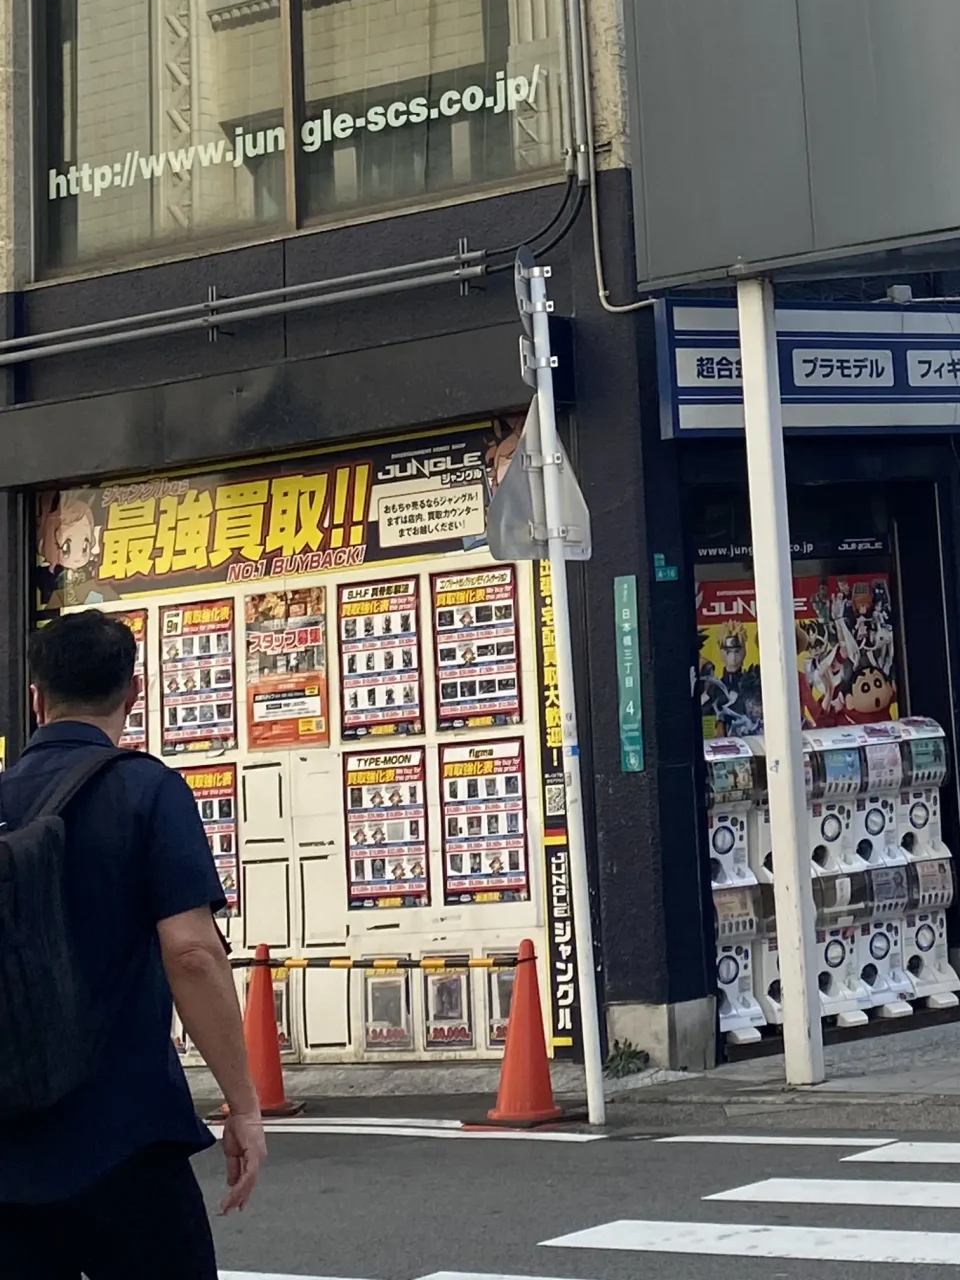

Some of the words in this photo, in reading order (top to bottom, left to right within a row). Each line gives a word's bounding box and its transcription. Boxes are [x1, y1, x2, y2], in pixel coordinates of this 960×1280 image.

[801, 356, 886, 380] プラモデル
[377, 451, 482, 478] JUNGLE
[441, 468, 483, 484] ジャングル
[98, 463, 372, 580] 最強買取!!
[226, 558, 267, 584] NO.1
[271, 544, 367, 578] BUYBACK!
[702, 596, 808, 618] JUNE
[249, 627, 323, 654] スタッフ募集
[625, 700, 635, 716] 4
[356, 754, 413, 768] TYPE-MOON
[554, 920, 575, 1031] ジャングル
